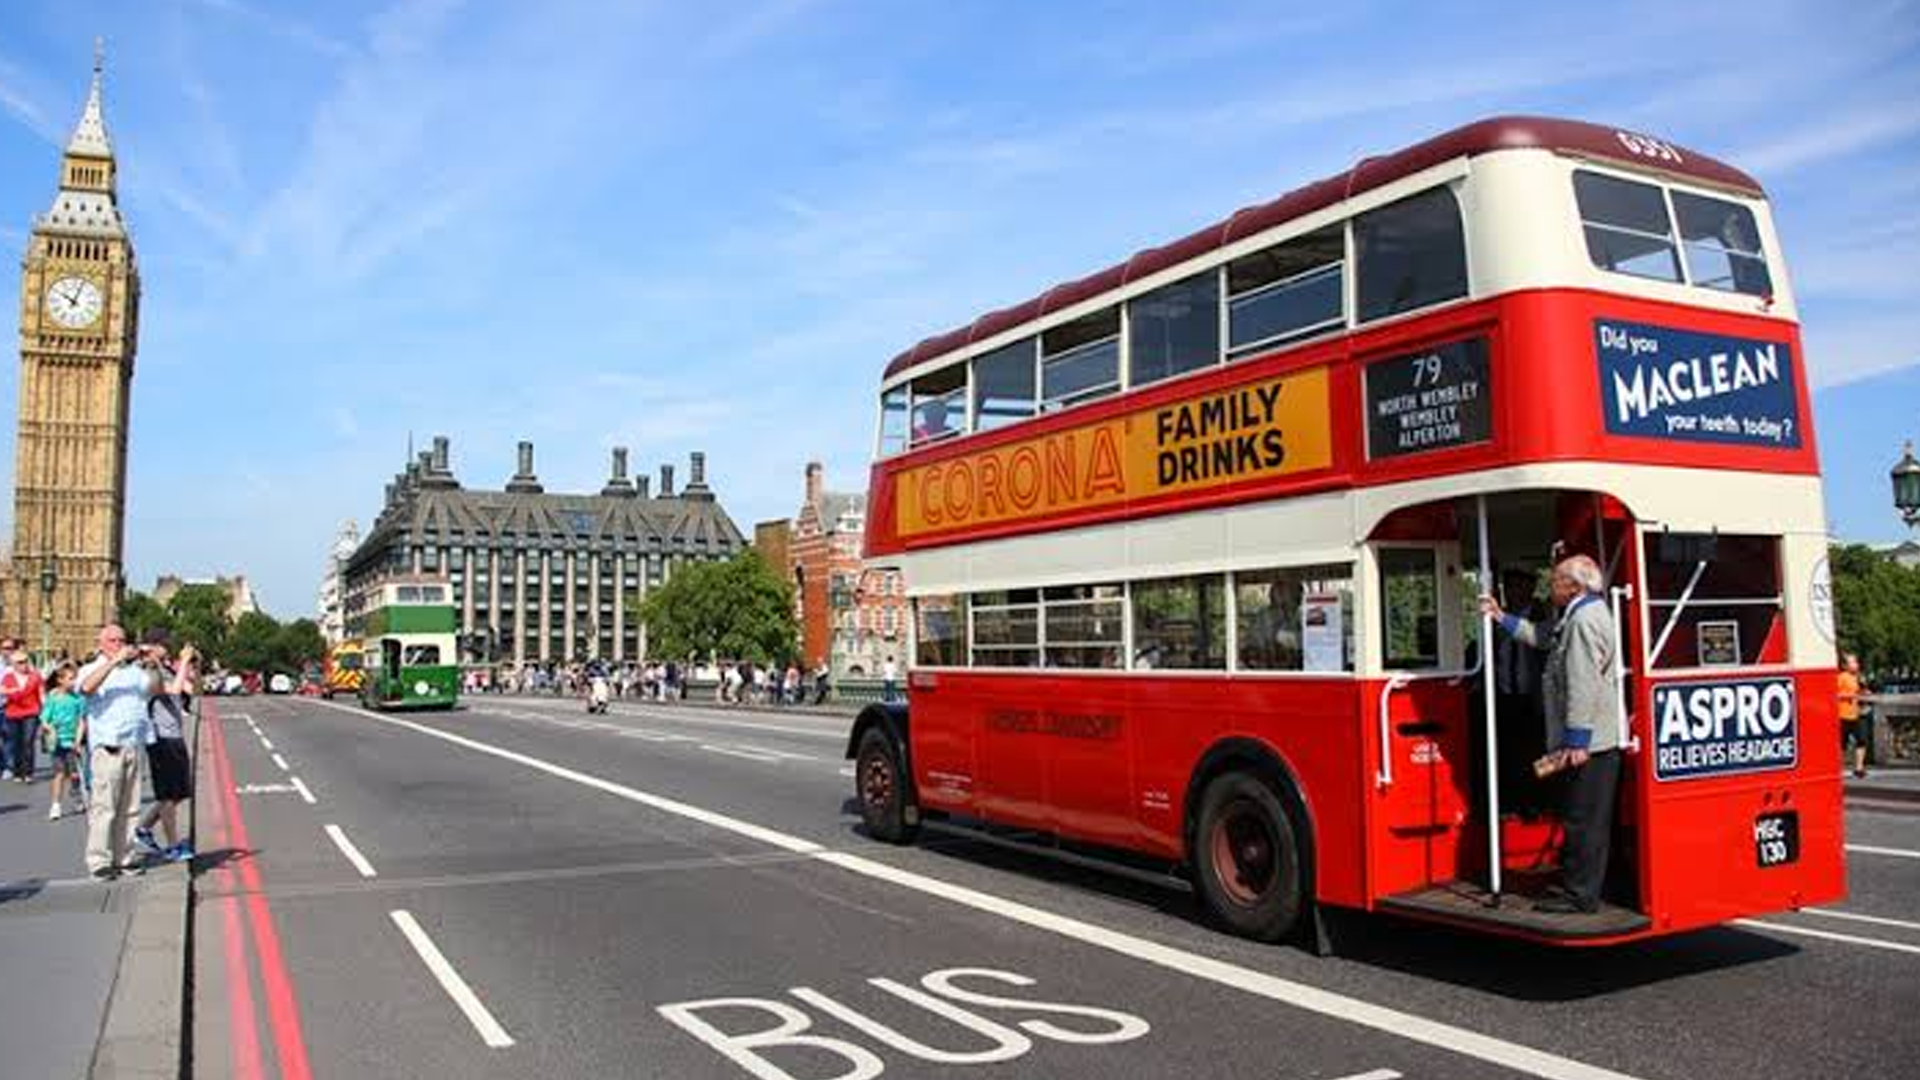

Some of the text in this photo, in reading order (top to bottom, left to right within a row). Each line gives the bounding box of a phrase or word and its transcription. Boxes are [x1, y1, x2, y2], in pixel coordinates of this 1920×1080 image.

[1600, 325, 1658, 356] Did you
[1412, 355, 1441, 387] 79
[1613, 344, 1779, 424] MACLEAN
[1421, 382, 1477, 407] WEMBLEY
[1157, 383, 1282, 446] FAMILY
[1401, 405, 1457, 429] WEMBLEY
[1665, 414, 1697, 435] your
[1700, 414, 1739, 434] teeth
[1399, 422, 1460, 446] ALPERTON
[1158, 429, 1285, 486] DRINKS
[1658, 736, 1794, 771] RELIEVES HEADACHE
[655, 967, 1151, 1080] BUS
